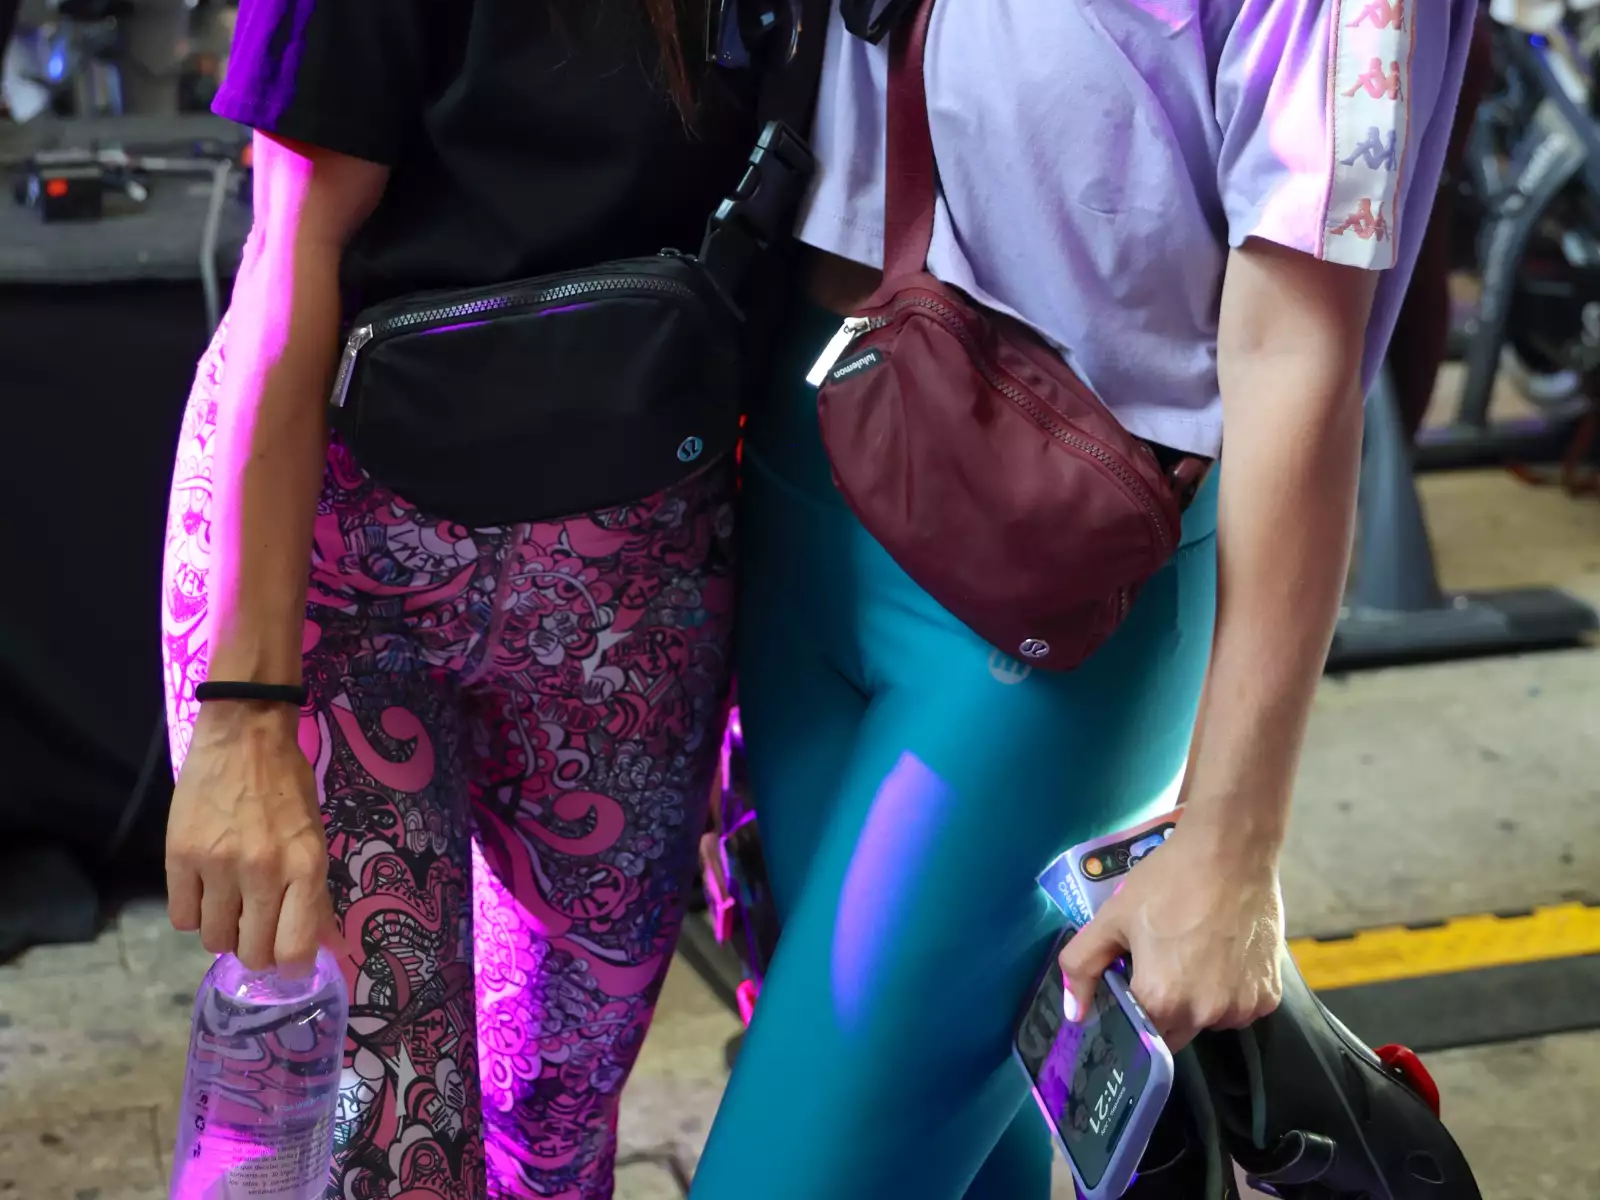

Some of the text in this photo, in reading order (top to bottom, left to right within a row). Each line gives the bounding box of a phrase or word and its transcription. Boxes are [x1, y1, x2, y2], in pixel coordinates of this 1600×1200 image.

[833, 352, 877, 379] lululemon
[1065, 873, 1090, 919] VIAJAR
[1089, 1068, 1124, 1134] 11:21
